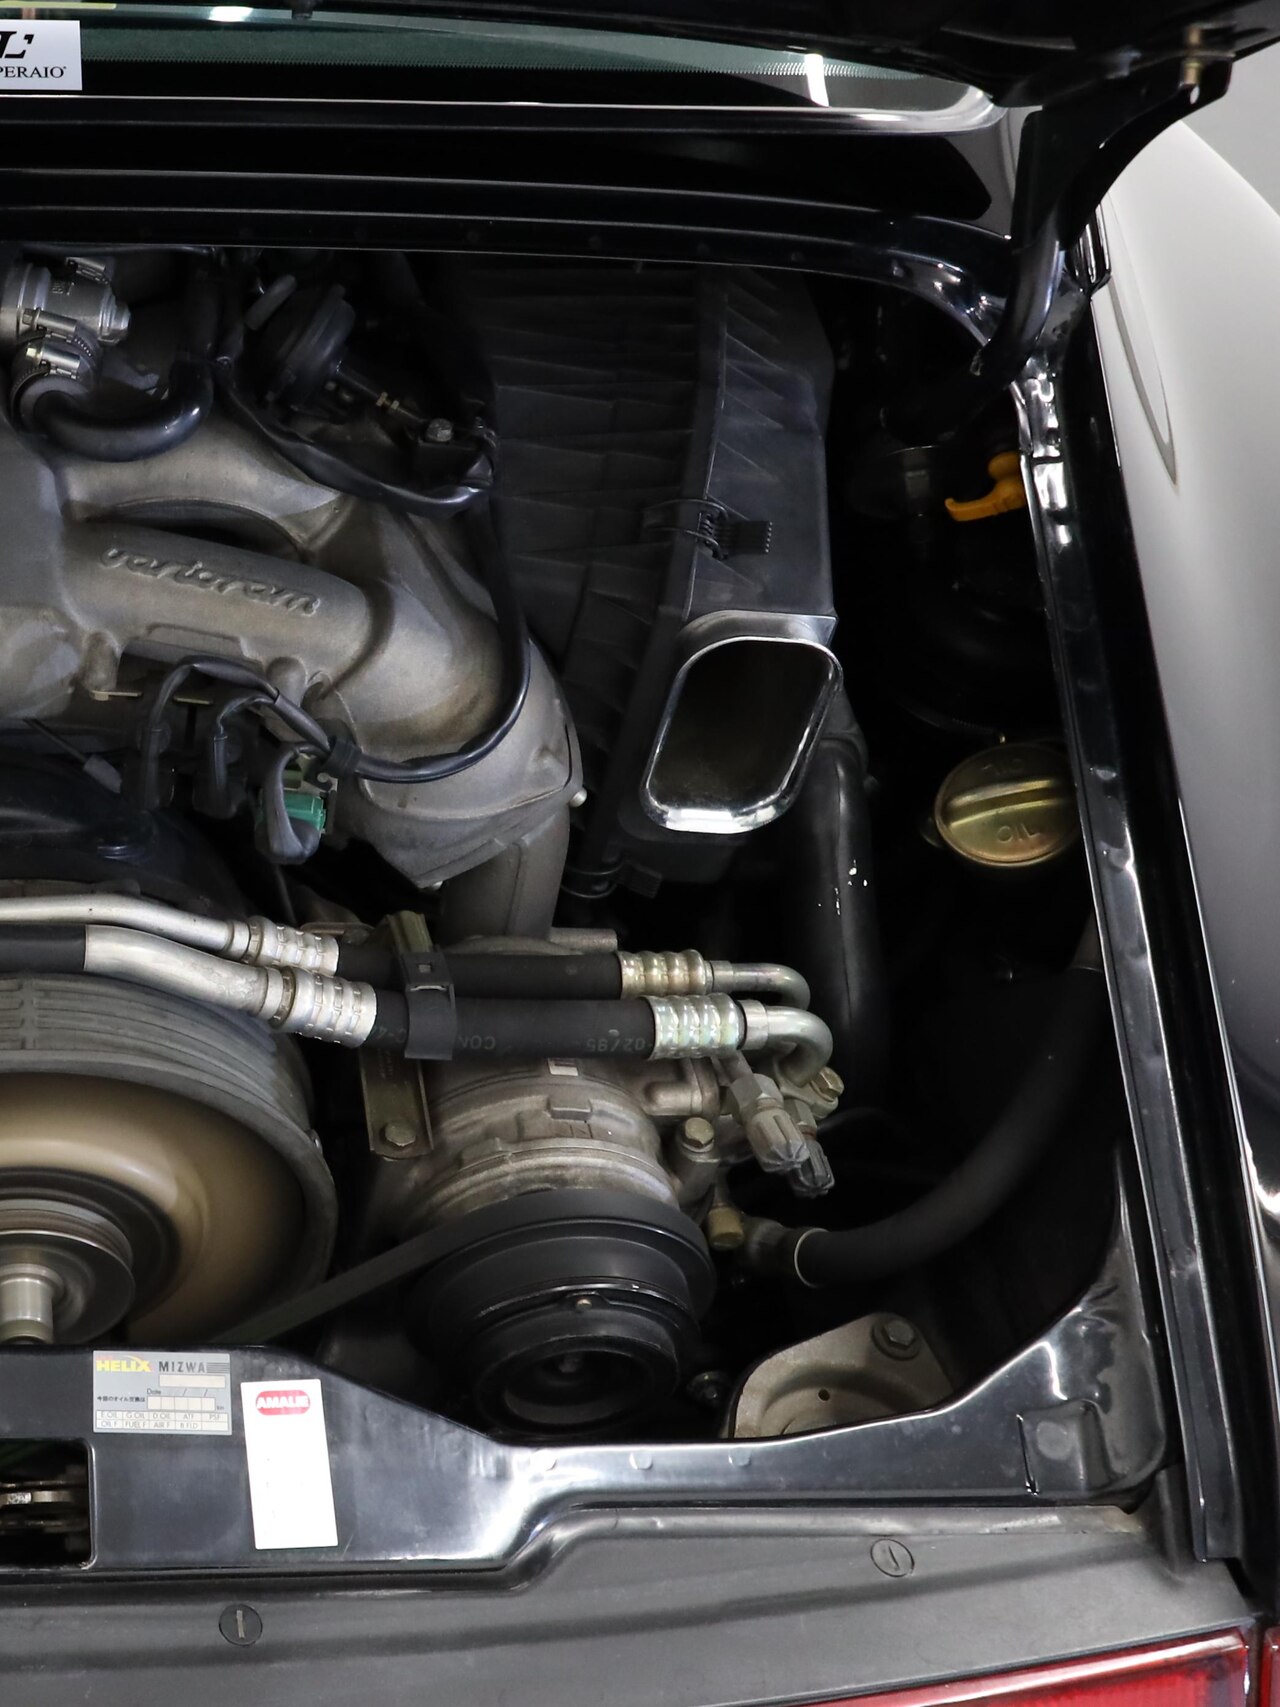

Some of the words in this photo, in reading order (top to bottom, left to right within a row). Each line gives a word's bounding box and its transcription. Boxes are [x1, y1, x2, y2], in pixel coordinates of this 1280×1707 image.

[997, 823, 1041, 844] OIL
[96, 1360, 151, 1372] HELIX
[158, 1360, 206, 1373] MIZWA
